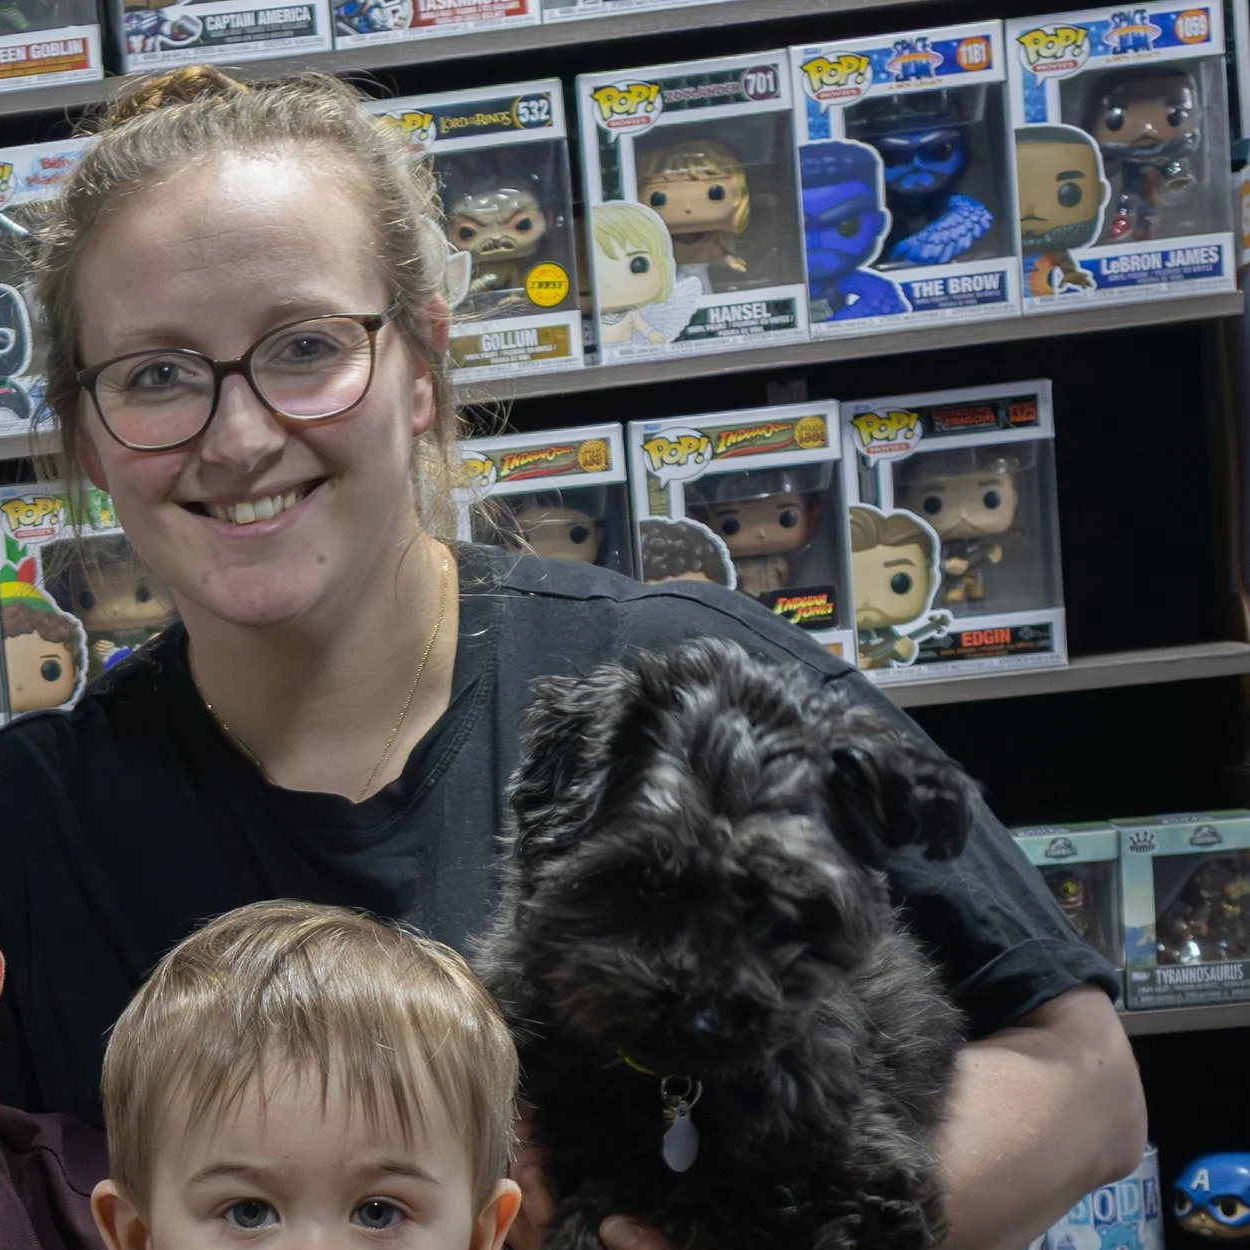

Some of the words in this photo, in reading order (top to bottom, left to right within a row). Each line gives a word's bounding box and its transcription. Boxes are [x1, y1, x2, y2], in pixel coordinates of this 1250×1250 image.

[206, 11, 258, 31] CAPTAIN
[259, 5, 312, 25] AMERICA
[29, 38, 84, 62] GOBLIN
[1017, 27, 1088, 64] POP!
[747, 72, 776, 98] 701
[802, 54, 869, 92] POP!
[517, 99, 550, 123] 532
[591, 83, 661, 120] POP!
[1165, 247, 1220, 269] JAMES
[911, 281, 947, 298] THE
[949, 273, 1000, 293] BROW
[710, 302, 772, 323] HANSEL
[481, 328, 539, 352] GOLLUM
[852, 411, 918, 448] POP!
[642, 435, 710, 472] POP!
[961, 627, 1012, 648] EDGIN
[1155, 964, 1243, 985] TYRANNOSAURUS
[1190, 1168, 1211, 1192] A
